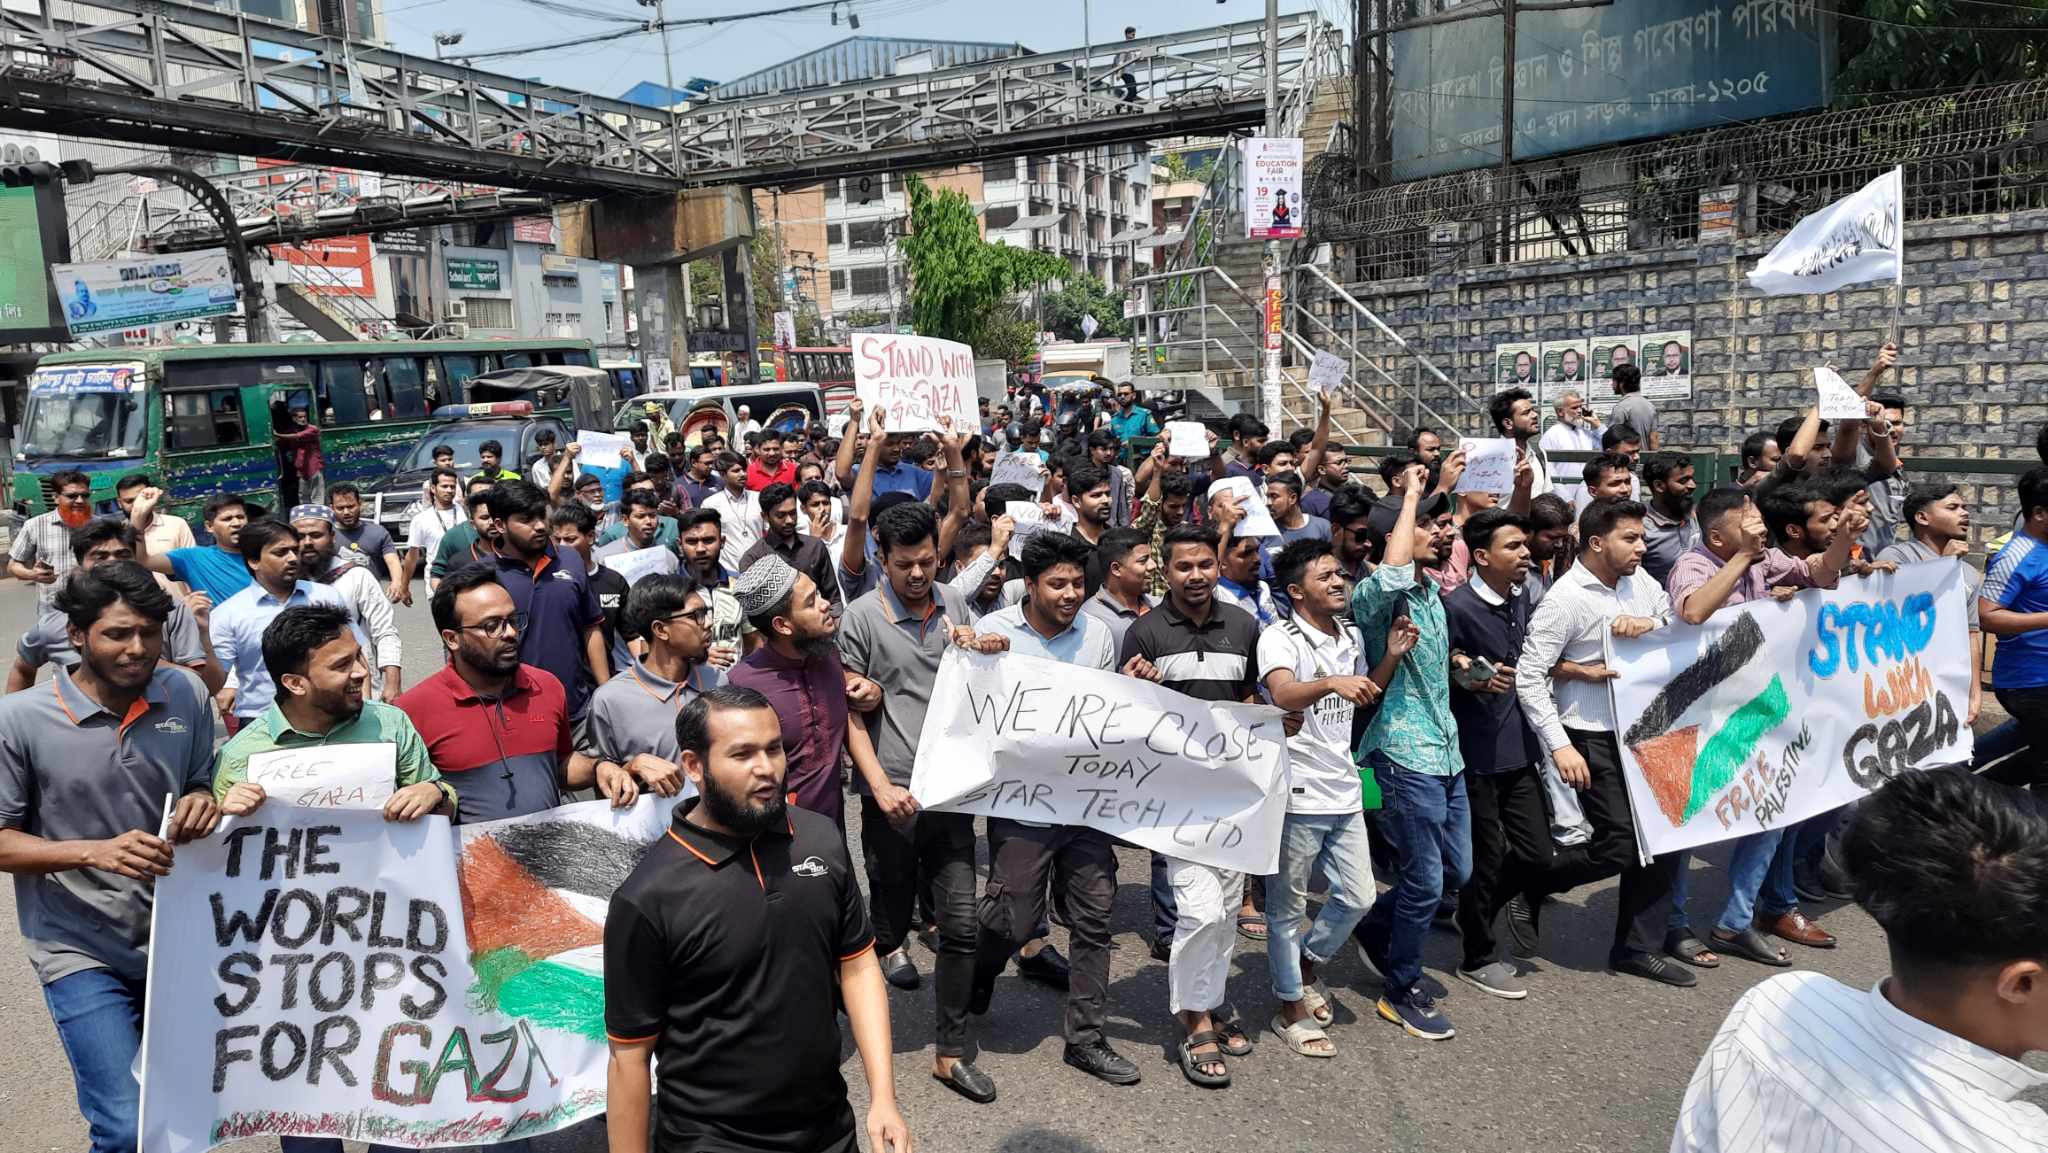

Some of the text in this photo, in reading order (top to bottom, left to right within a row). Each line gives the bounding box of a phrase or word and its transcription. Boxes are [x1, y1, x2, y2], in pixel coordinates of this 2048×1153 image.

[1632, 4, 1721, 61] গবেষণা
[1255, 160, 1298, 169] EDUCATION
[1256, 186, 1269, 197] 19
[1266, 167, 1284, 176] FAIR
[861, 336, 975, 381] STAND WITH
[912, 379, 962, 417] GAZA
[1808, 590, 1937, 680] STAND
[966, 681, 1052, 736] WE
[1145, 711, 1266, 763] CLOSE
[1842, 690, 1959, 790] GAZA
[256, 754, 335, 785] FREE
[296, 785, 365, 808] GAZA
[1065, 754, 1163, 788] TODAY
[1714, 750, 1776, 832] FREE
[1754, 717, 1812, 831] PALESTINE
[958, 779, 1244, 849] STAR TECH LTD
[223, 825, 342, 881] THE
[208, 886, 449, 954] WORLD
[213, 951, 449, 1020] STOPS
[212, 1015, 560, 1107] FOR GAZA
